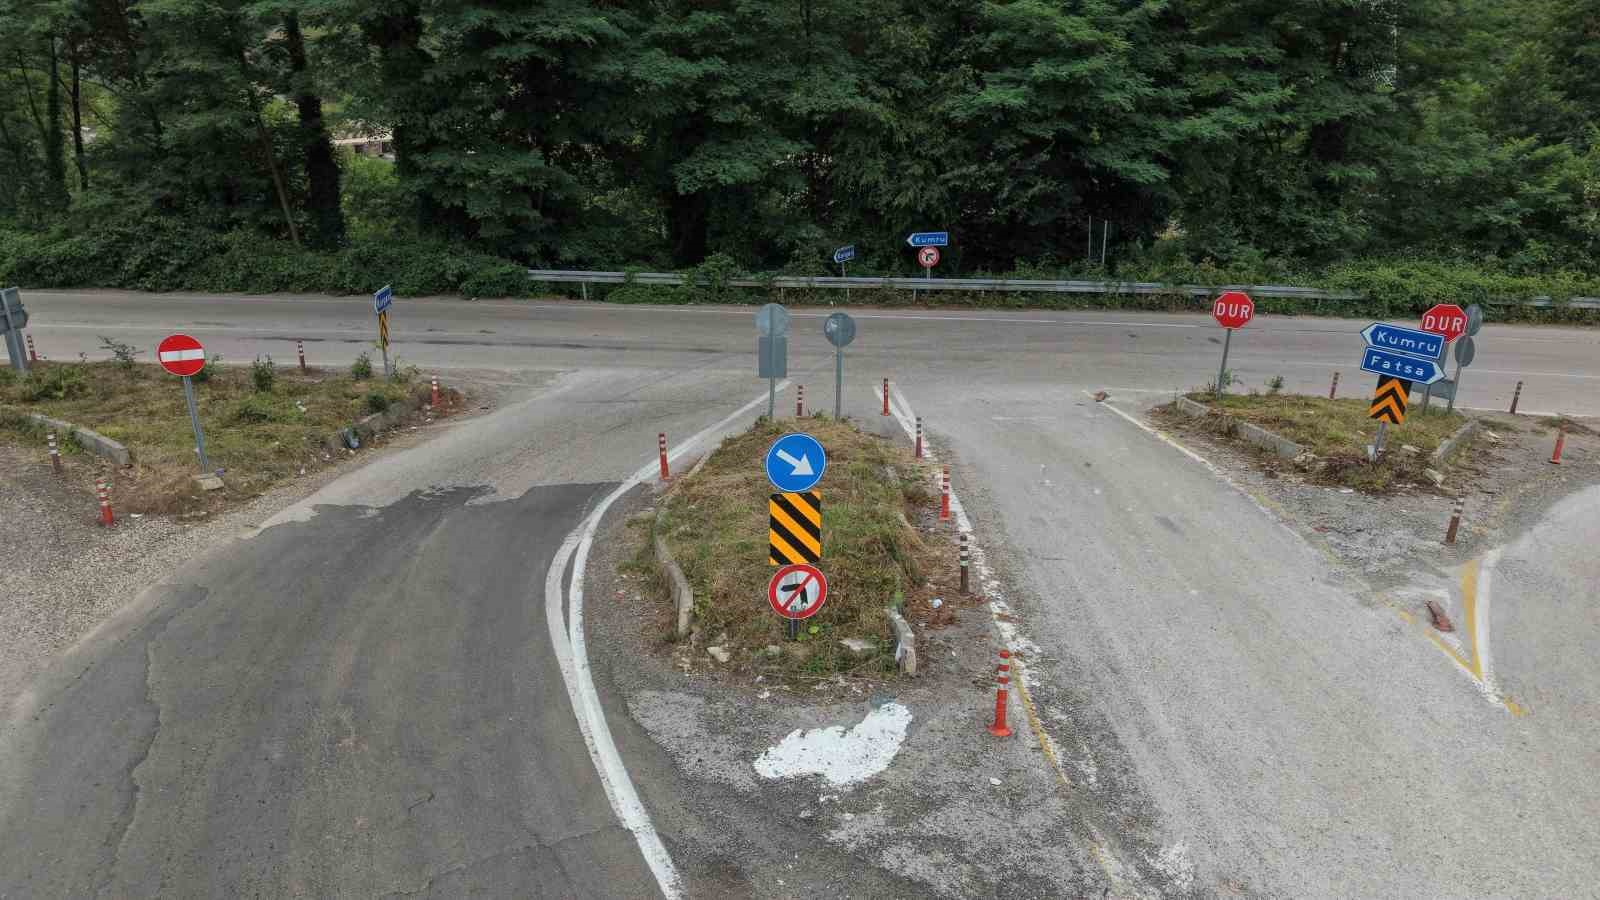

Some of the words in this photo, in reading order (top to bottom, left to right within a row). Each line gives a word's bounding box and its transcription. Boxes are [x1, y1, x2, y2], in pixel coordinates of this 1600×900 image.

[1216, 302, 1250, 319] DUR
[1424, 315, 1463, 332] DUR
[1376, 331, 1437, 353] Kumru
[1370, 355, 1425, 377] Fatsa
